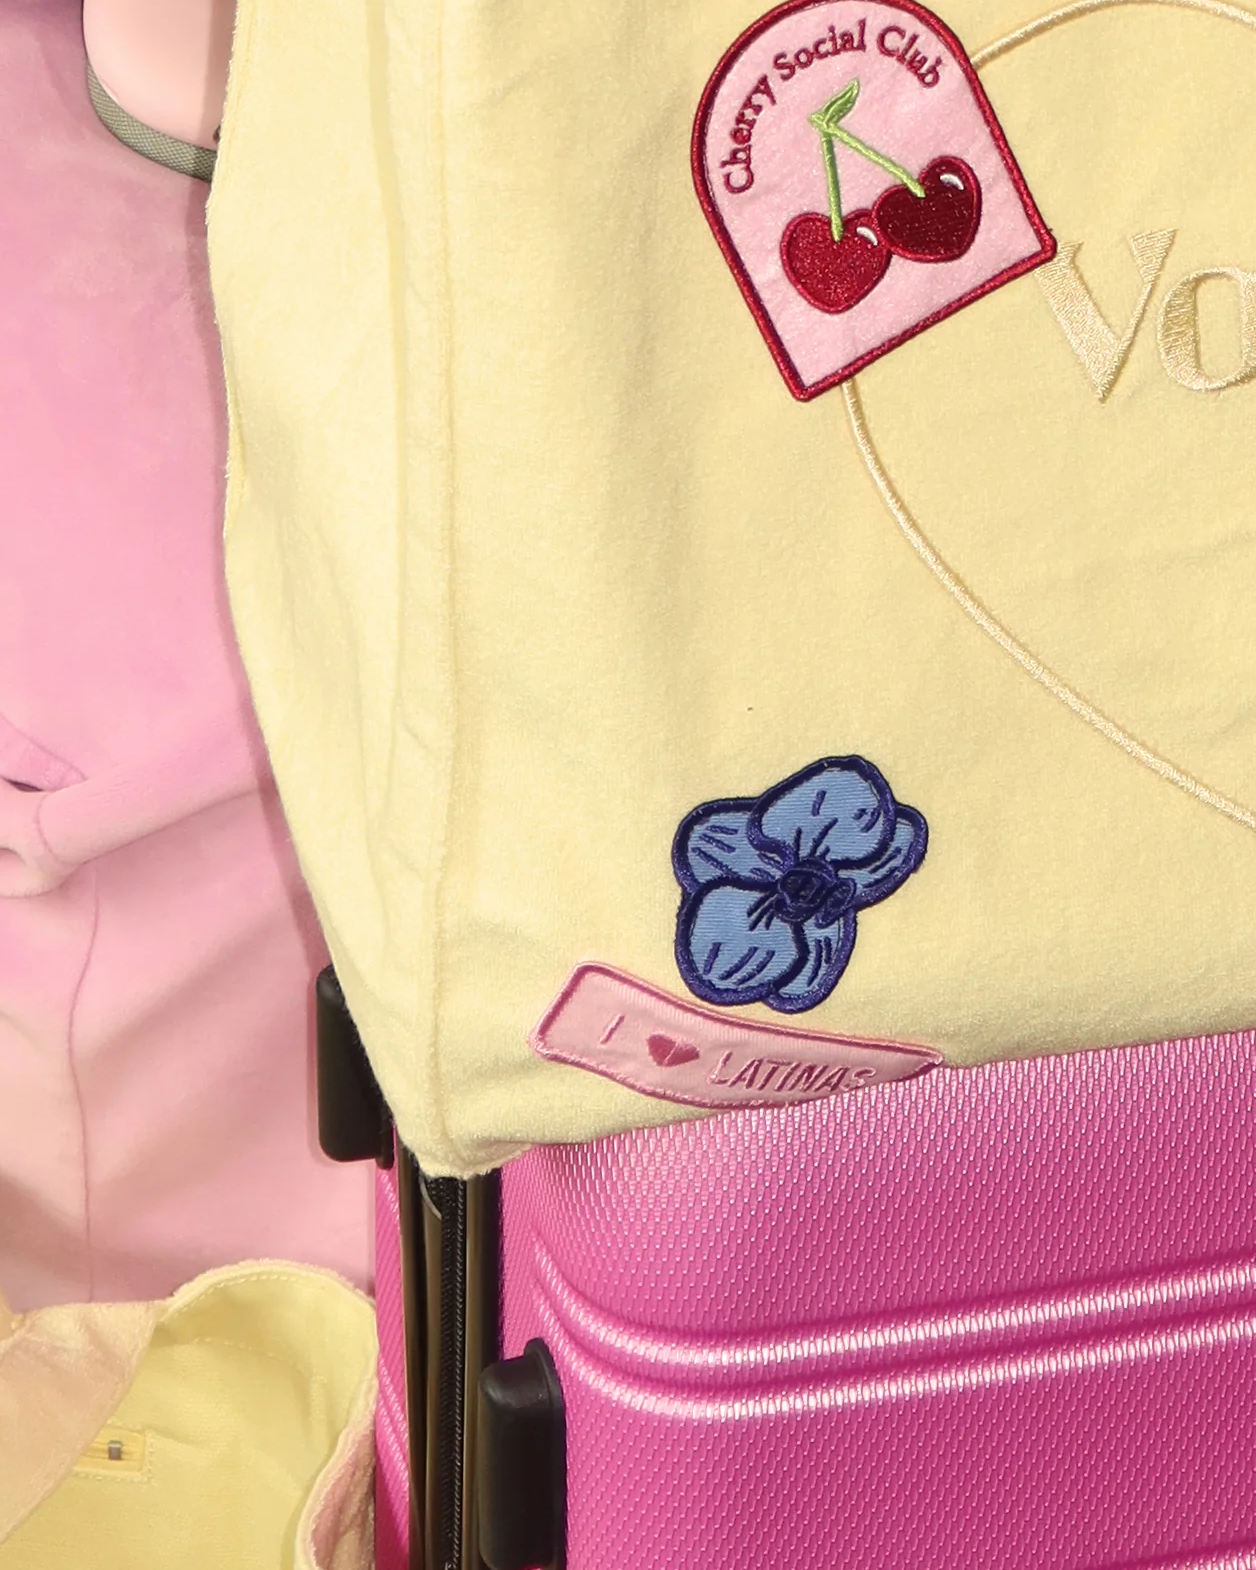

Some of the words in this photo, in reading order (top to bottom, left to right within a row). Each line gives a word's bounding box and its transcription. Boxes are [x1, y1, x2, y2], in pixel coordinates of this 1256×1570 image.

[722, 74, 777, 194] Cherry
[773, 18, 868, 82] Social
[876, 25, 941, 89] Club
[600, 1014, 625, 1044] I
[706, 1050, 877, 1093] LATINAS
